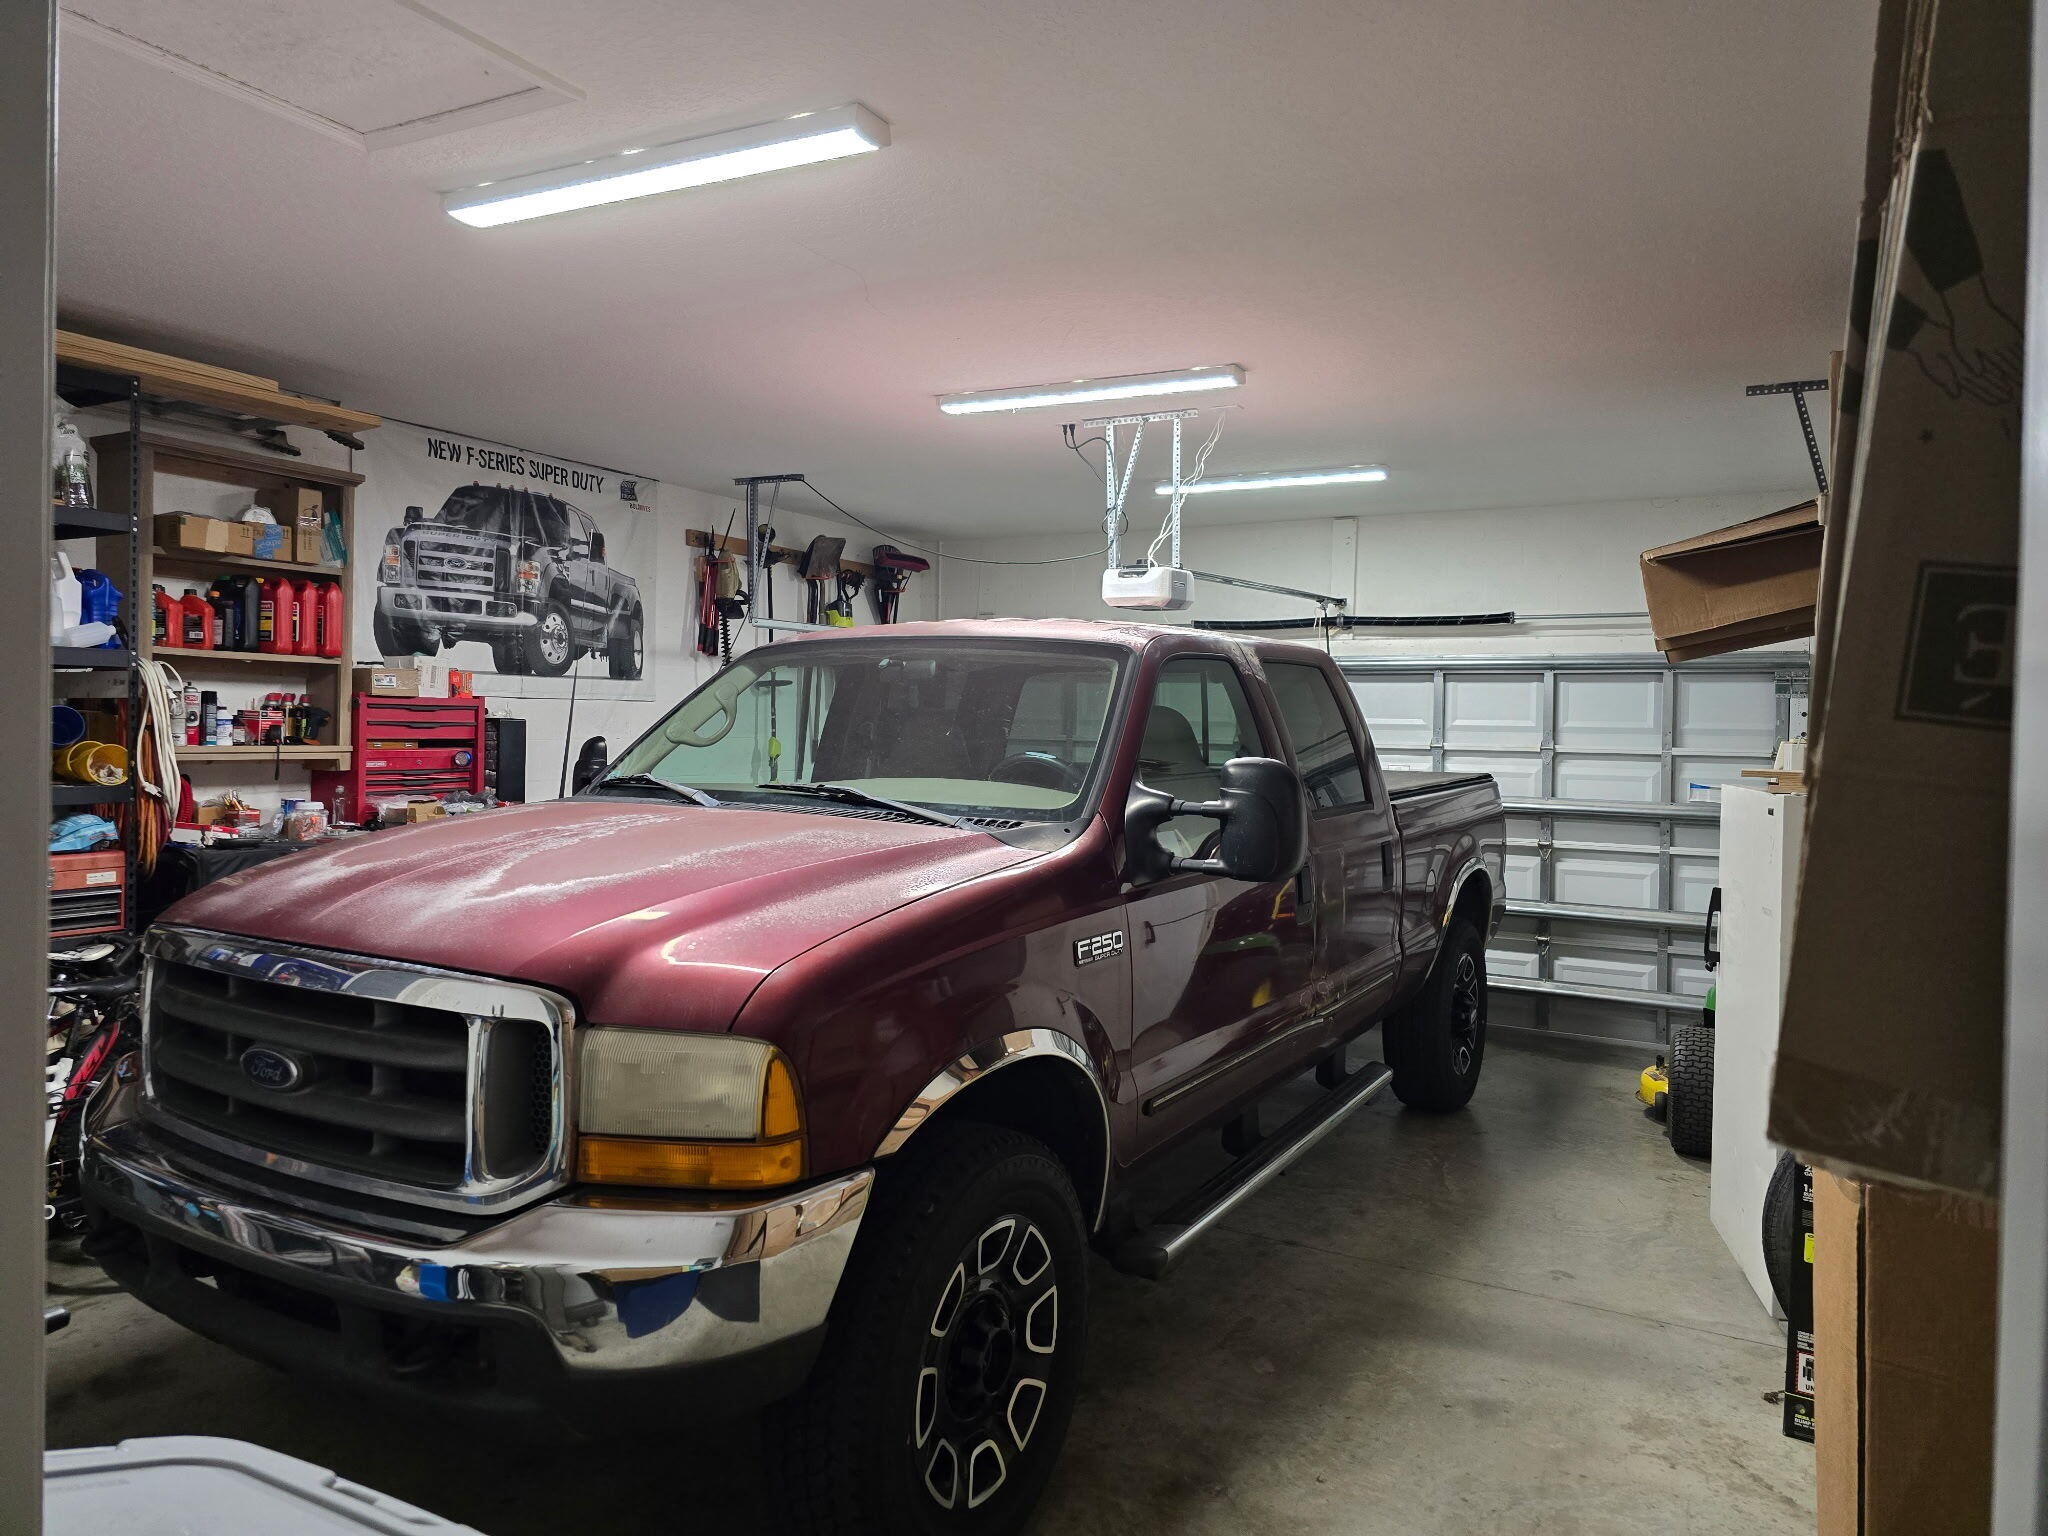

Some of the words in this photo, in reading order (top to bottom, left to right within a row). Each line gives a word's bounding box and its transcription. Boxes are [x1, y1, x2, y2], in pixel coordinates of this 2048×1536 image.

[427, 438, 461, 463] NEW
[466, 446, 525, 476] F-SERIES
[529, 459, 569, 487] SUPER
[572, 471, 605, 494] DUTY
[1094, 952, 1110, 960] SUPER
